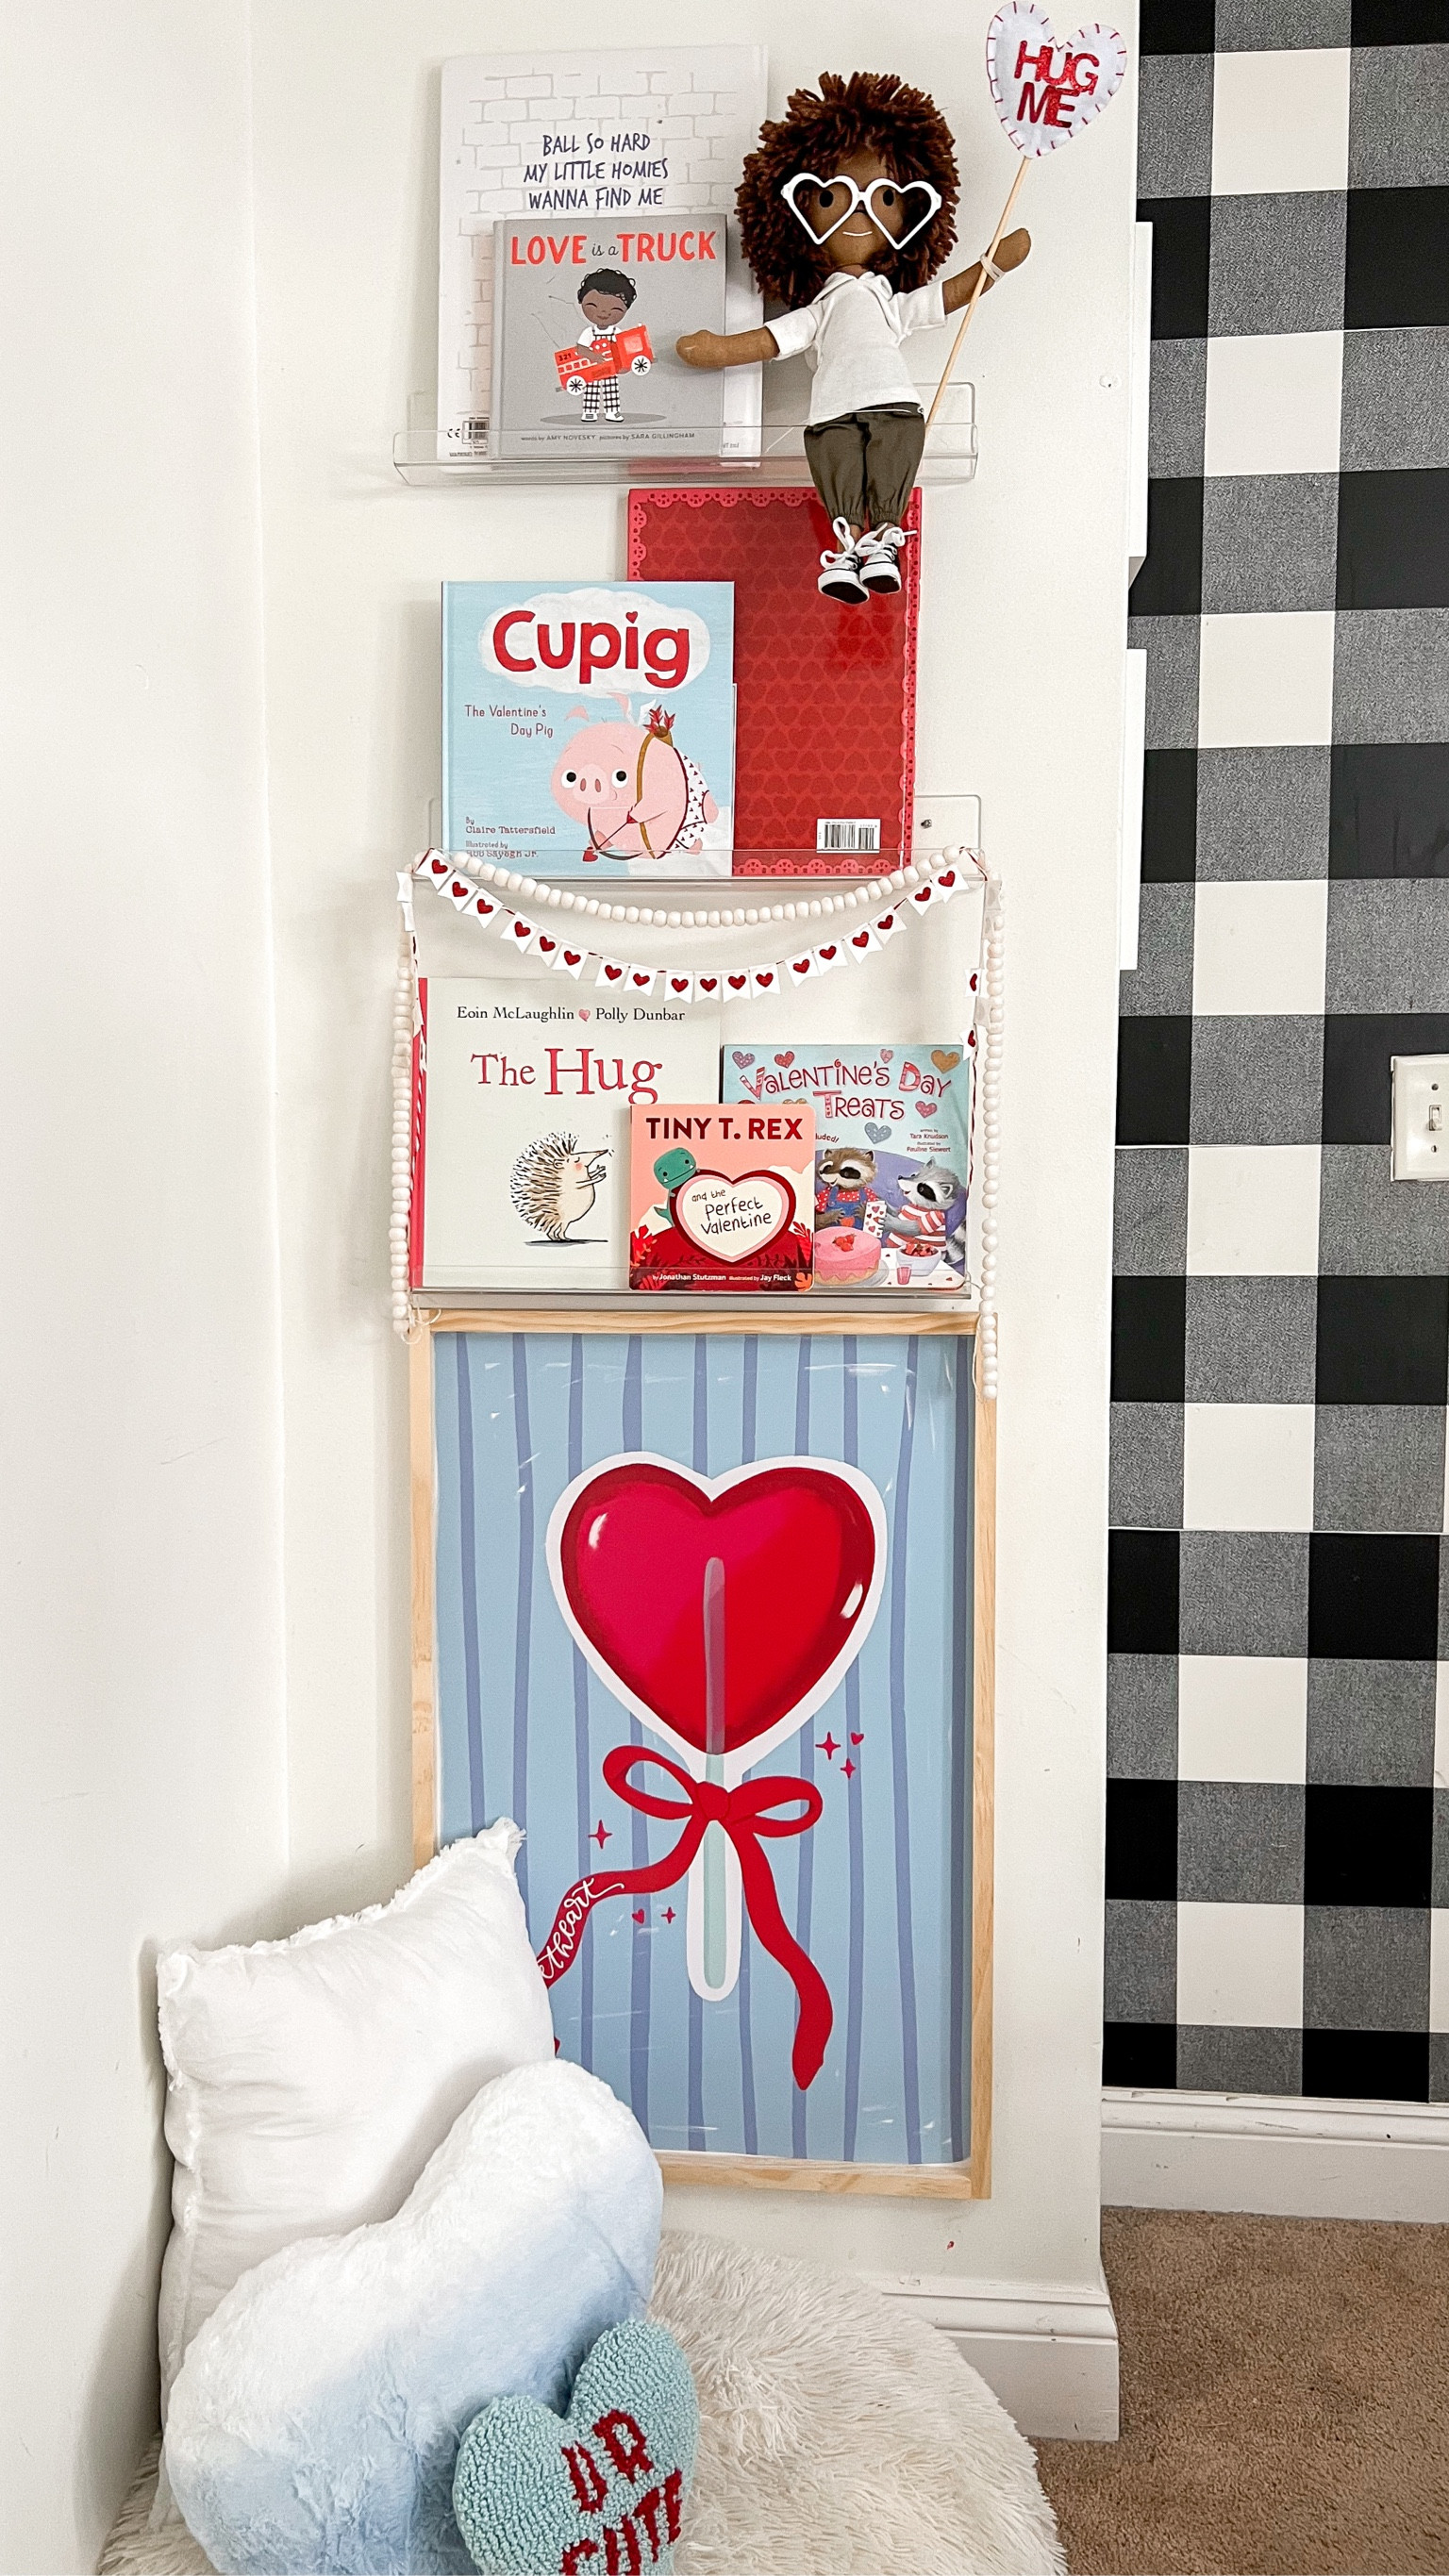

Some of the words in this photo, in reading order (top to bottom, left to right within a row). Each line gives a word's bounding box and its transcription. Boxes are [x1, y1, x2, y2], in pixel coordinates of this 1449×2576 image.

[1013, 40, 1100, 96] HUG
[1016, 81, 1080, 129] ME
[541, 132, 580, 157] BALL
[586, 131, 605, 155] SO
[609, 131, 652, 153] HARD
[523, 162, 547, 183] MY
[554, 159, 606, 181] LITTLE
[611, 157, 670, 180] HOMIES
[527, 189, 589, 211] WANNA
[595, 187, 632, 208] FIND
[638, 187, 663, 207] ME
[510, 234, 587, 266] LOVE
[591, 241, 606, 258] is
[608, 242, 619, 258] a
[616, 230, 716, 262] TRUCK
[492, 609, 691, 689] Cupig
[464, 705, 485, 718] The
[489, 705, 547, 719] Valentine's
[509, 723, 533, 739] Day
[534, 723, 554, 739] Pig
[466, 816, 475, 824] By
[498, 826, 556, 835] Tattersfield
[457, 1005, 489, 1021] Eoin
[492, 1005, 575, 1022] McLaughlin
[595, 1007, 628, 1023] Polly
[633, 1008, 686, 1022] Dunbar
[470, 1052, 537, 1087] The
[543, 1047, 663, 1105] Hug
[645, 1116, 718, 1141] TINY
[718, 1117, 741, 1140] T.
[748, 1117, 804, 1140] REX
[815, 1133, 840, 1143] luded!
[691, 1190, 710, 1202] and
[711, 1188, 726, 1200] the
[700, 1211, 773, 1234] valentine
[536, 1877, 625, 1979] etheart
[560, 2408, 655, 2514] UR
